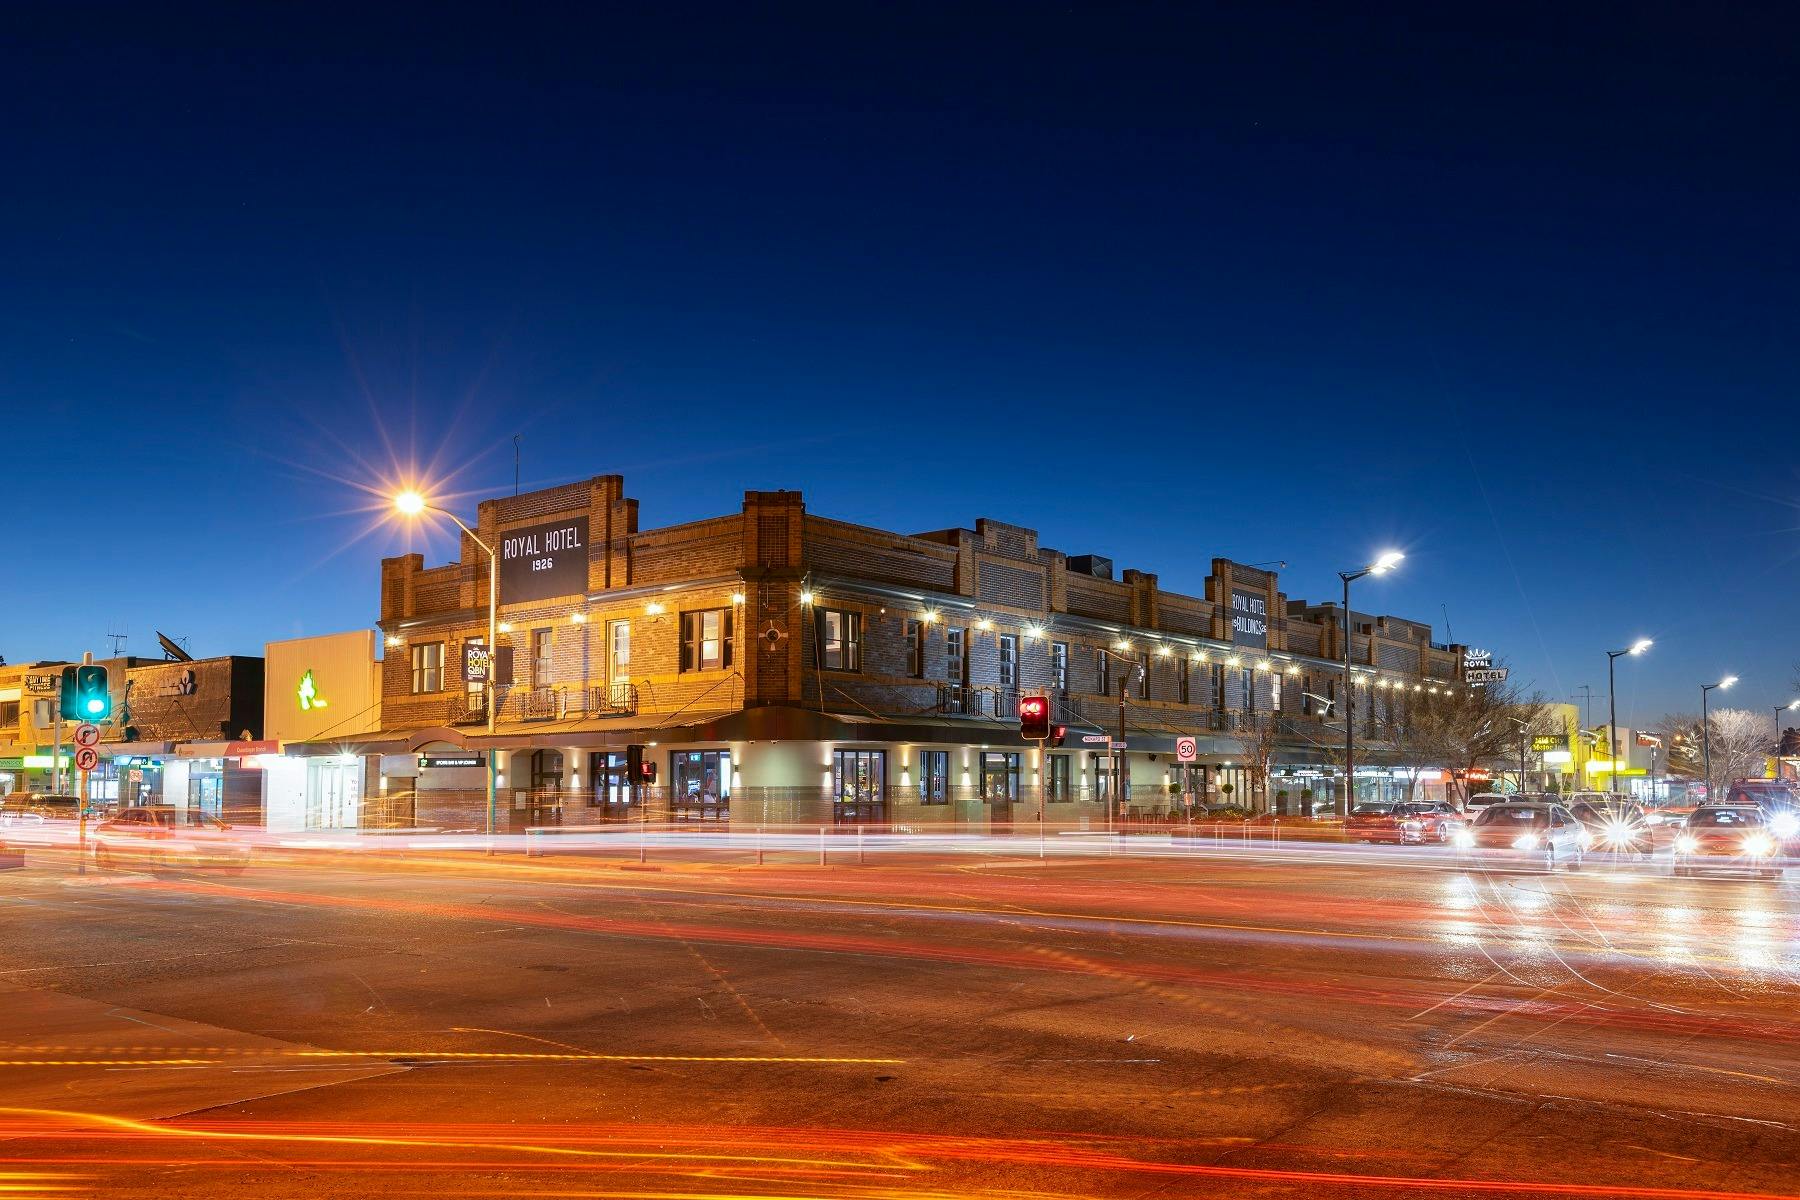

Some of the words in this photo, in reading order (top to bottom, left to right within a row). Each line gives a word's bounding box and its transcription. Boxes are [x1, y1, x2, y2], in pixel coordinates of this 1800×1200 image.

[504, 534, 540, 559] ROYAL
[546, 527, 581, 552] HOTEL
[532, 558, 553, 571] 1926
[1232, 594, 1249, 612] ROYAL
[1250, 597, 1266, 615] HOTEL
[468, 650, 488, 659] ROYA
[468, 667, 486, 676] QBN
[1468, 671, 1503, 680] HOTEL
